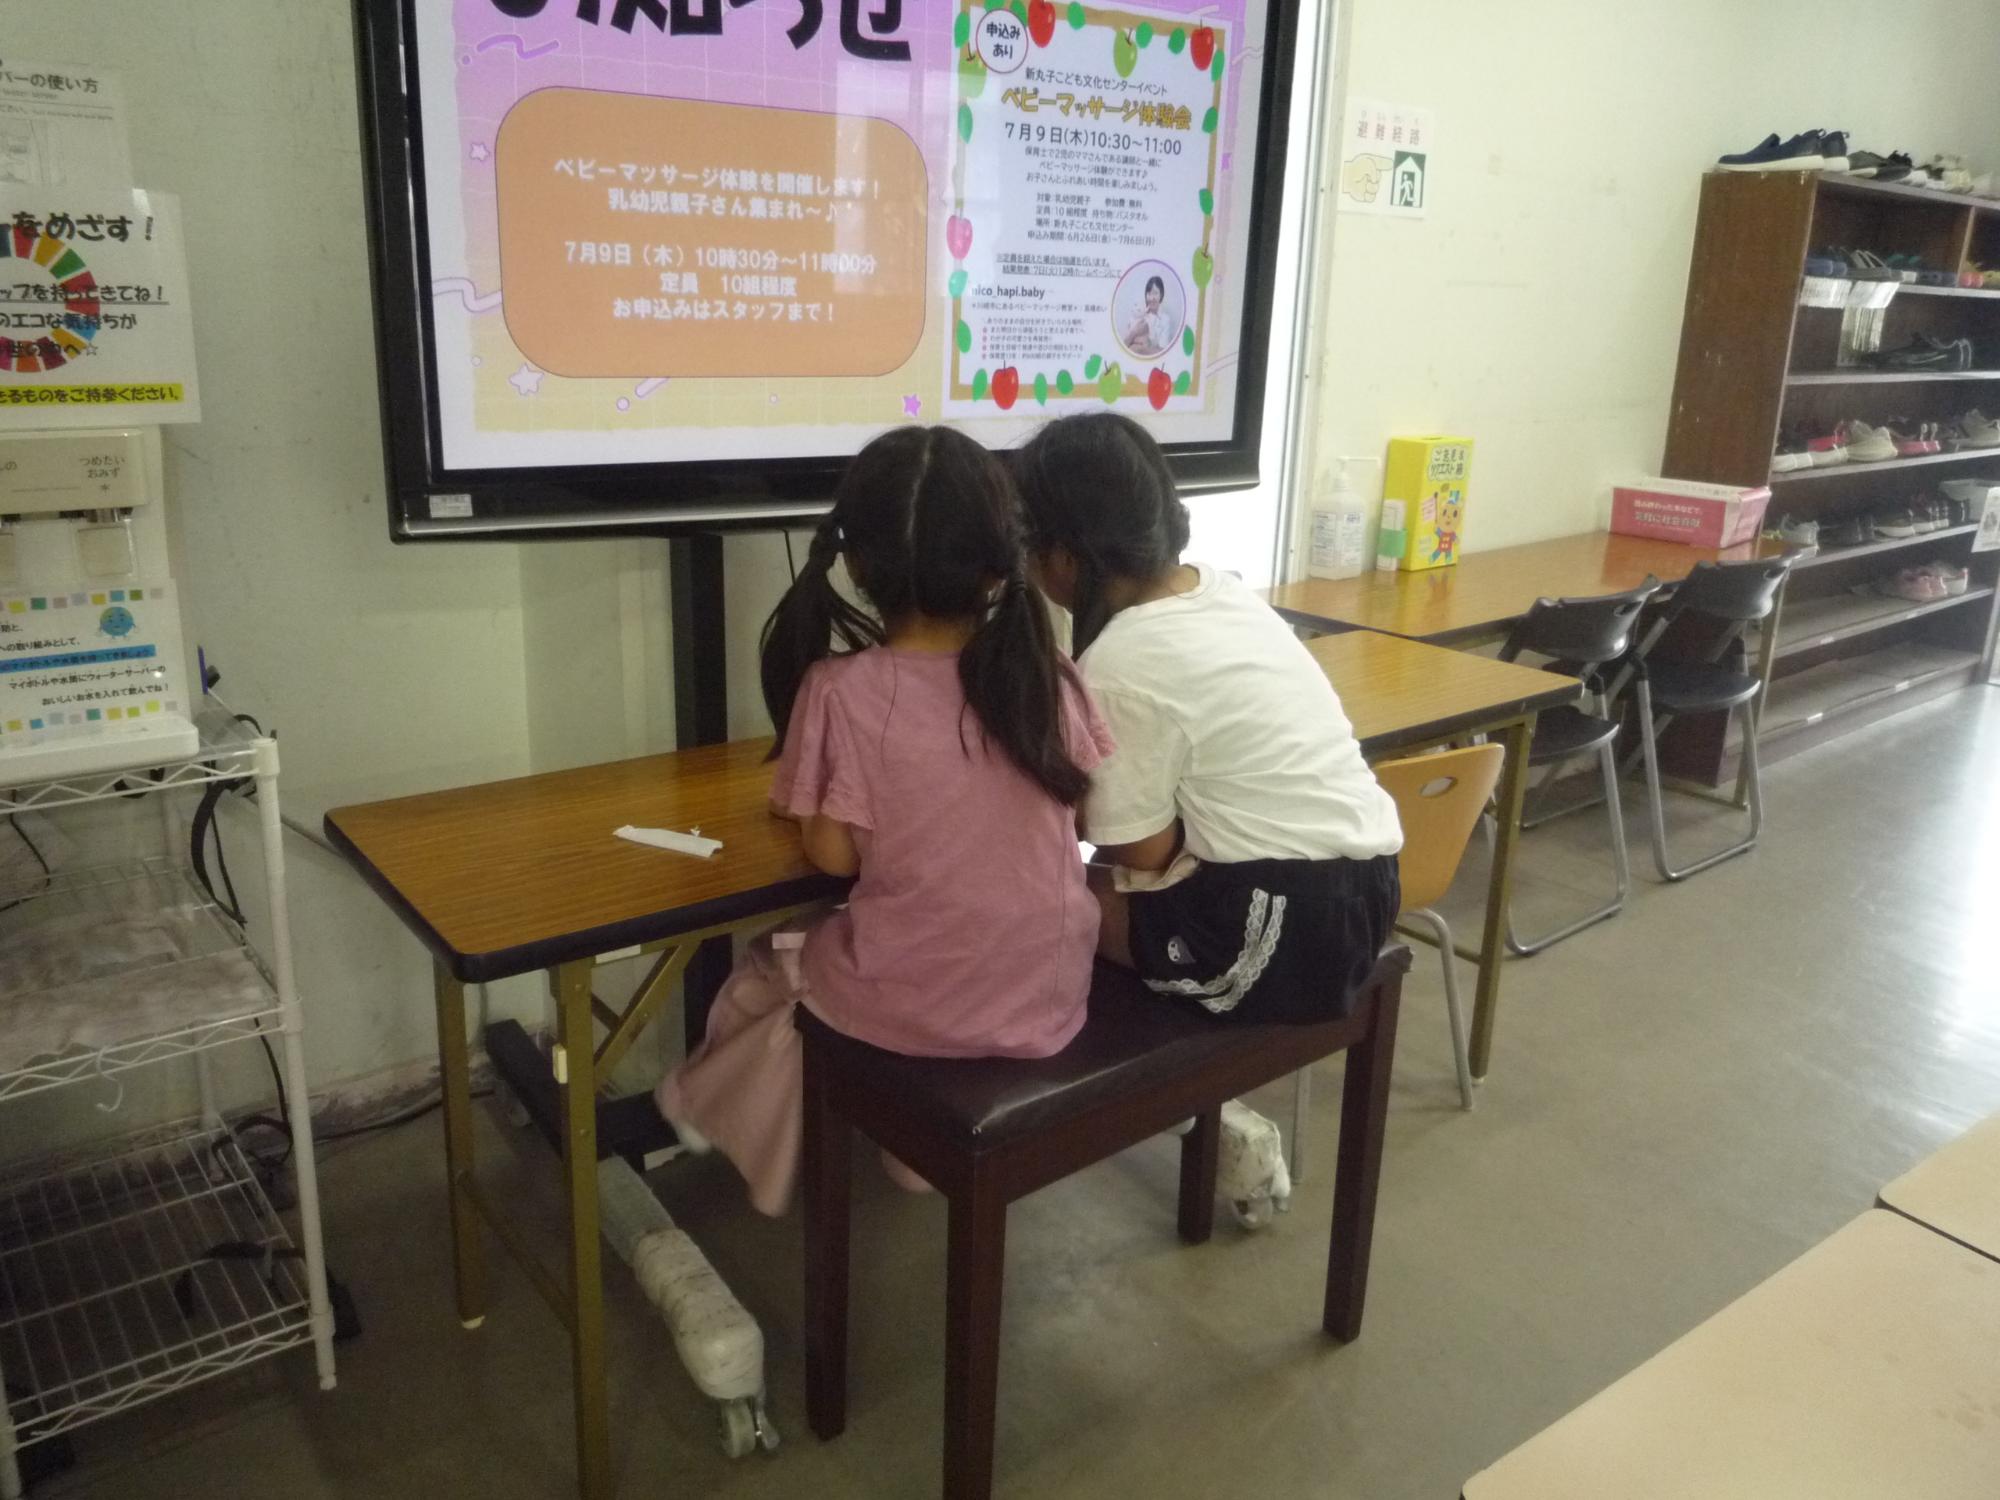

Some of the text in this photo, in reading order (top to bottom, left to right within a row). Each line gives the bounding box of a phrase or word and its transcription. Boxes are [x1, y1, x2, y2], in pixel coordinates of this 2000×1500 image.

[986, 21, 1021, 40] 申込み
[992, 43, 1014, 59] あり
[1026, 66, 1168, 97] 新丸子こども文化センターイベント
[1001, 86, 1192, 131] ベビーマッサージ体験会
[659, 271, 798, 297] 定員 10組程度
[613, 297, 835, 322] お申込みはスタッフまで！
